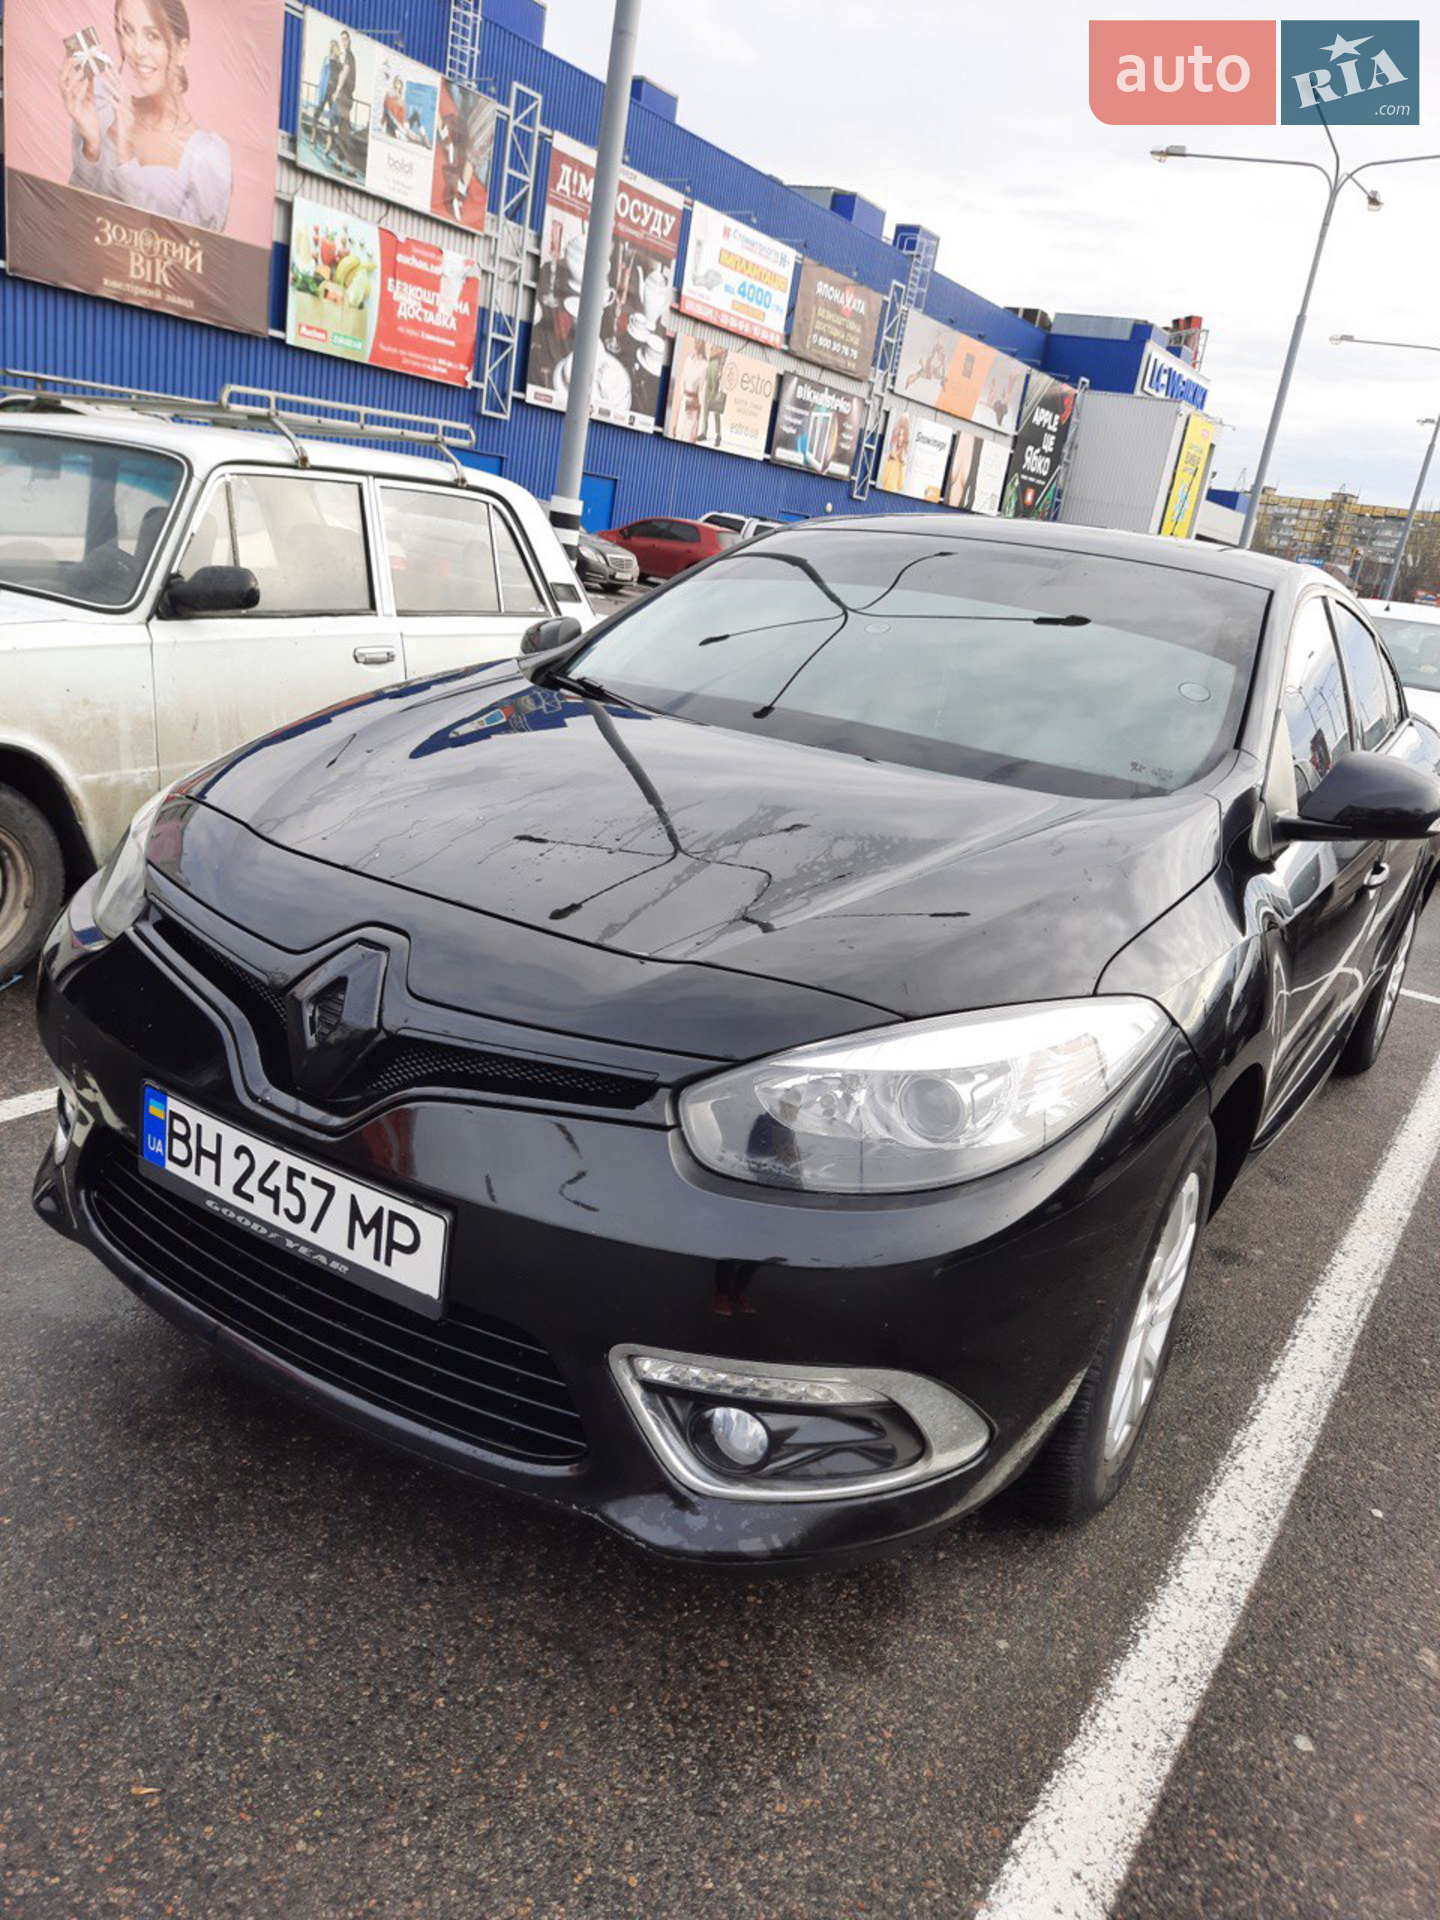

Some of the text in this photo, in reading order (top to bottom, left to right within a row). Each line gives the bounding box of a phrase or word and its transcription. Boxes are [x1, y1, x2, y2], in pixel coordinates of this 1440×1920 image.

[616, 192, 676, 239] ОСУДУ
[130, 251, 174, 289] ВІК
[738, 281, 772, 309] 4000
[396, 302, 457, 331] ДОСТАВКА
[740, 372, 773, 398] estro
[1032, 406, 1060, 433] APPLE
[1042, 433, 1056, 453] ЦЕ
[147, 1134, 164, 1156] UA
[168, 1109, 421, 1267] BH 2457 MP
